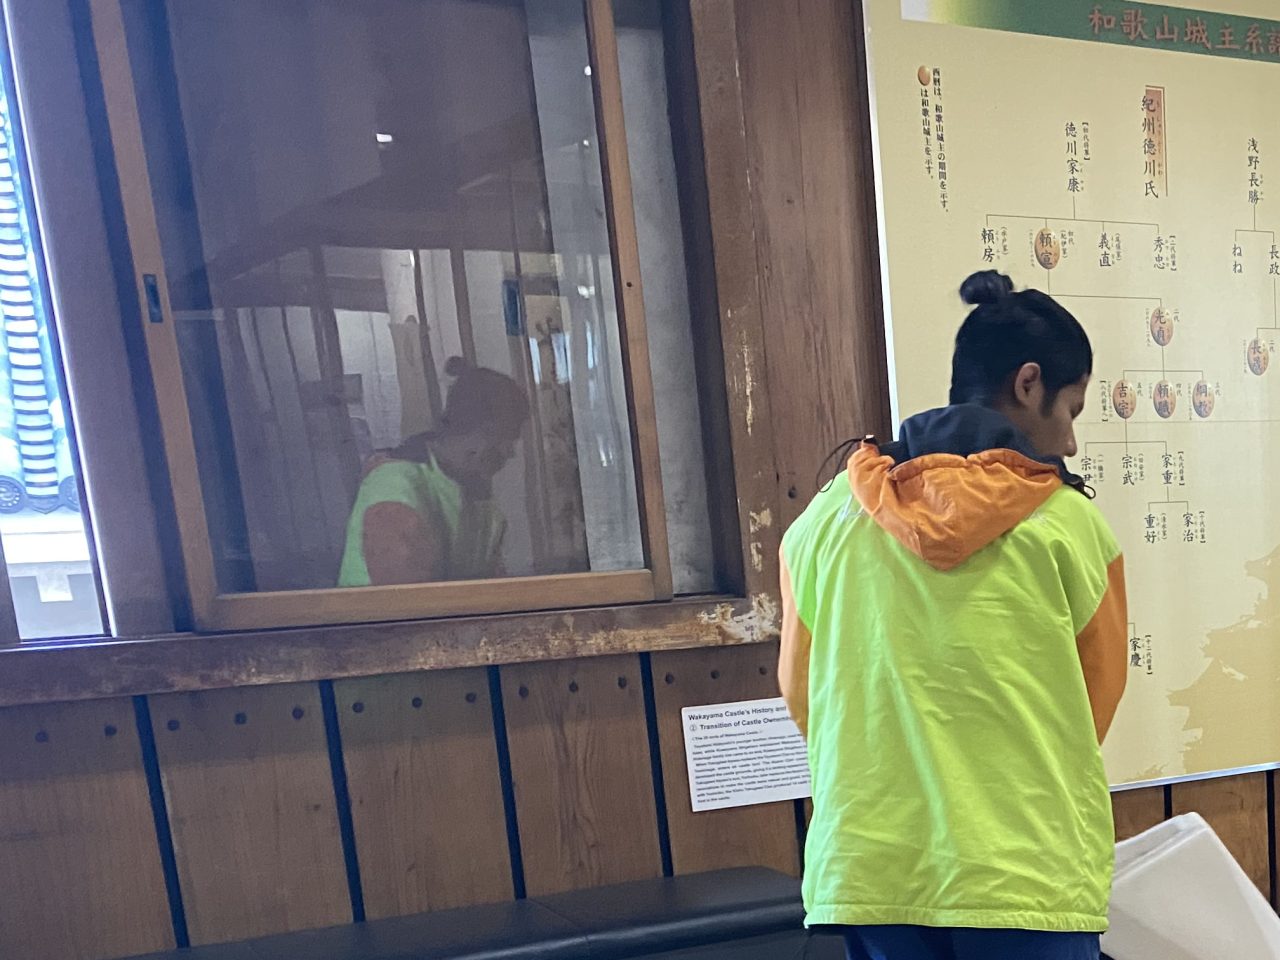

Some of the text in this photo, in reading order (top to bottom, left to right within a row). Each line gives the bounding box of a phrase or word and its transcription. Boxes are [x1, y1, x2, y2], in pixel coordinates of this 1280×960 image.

[1065, 121, 1080, 193] 徳川家康
[1141, 95, 1159, 199] 紀州徳川氏
[1247, 137, 1260, 206] 浅野長勝
[981, 227, 996, 263] 頼房
[1098, 233, 1111, 267] 義直
[1153, 236, 1166, 270] 秀忠
[1232, 243, 1244, 275] ねね
[1269, 244, 1280, 276] 長政
[1121, 454, 1135, 486] 宗武
[1161, 454, 1174, 486] 家重
[1144, 513, 1157, 545] 重好
[1182, 512, 1195, 543] 家治
[688, 711, 723, 721] Wakayama
[725, 709, 751, 717] Castle's
[752, 707, 774, 716] History
[700, 722, 733, 731] Transition
[742, 718, 762, 726] Castle
